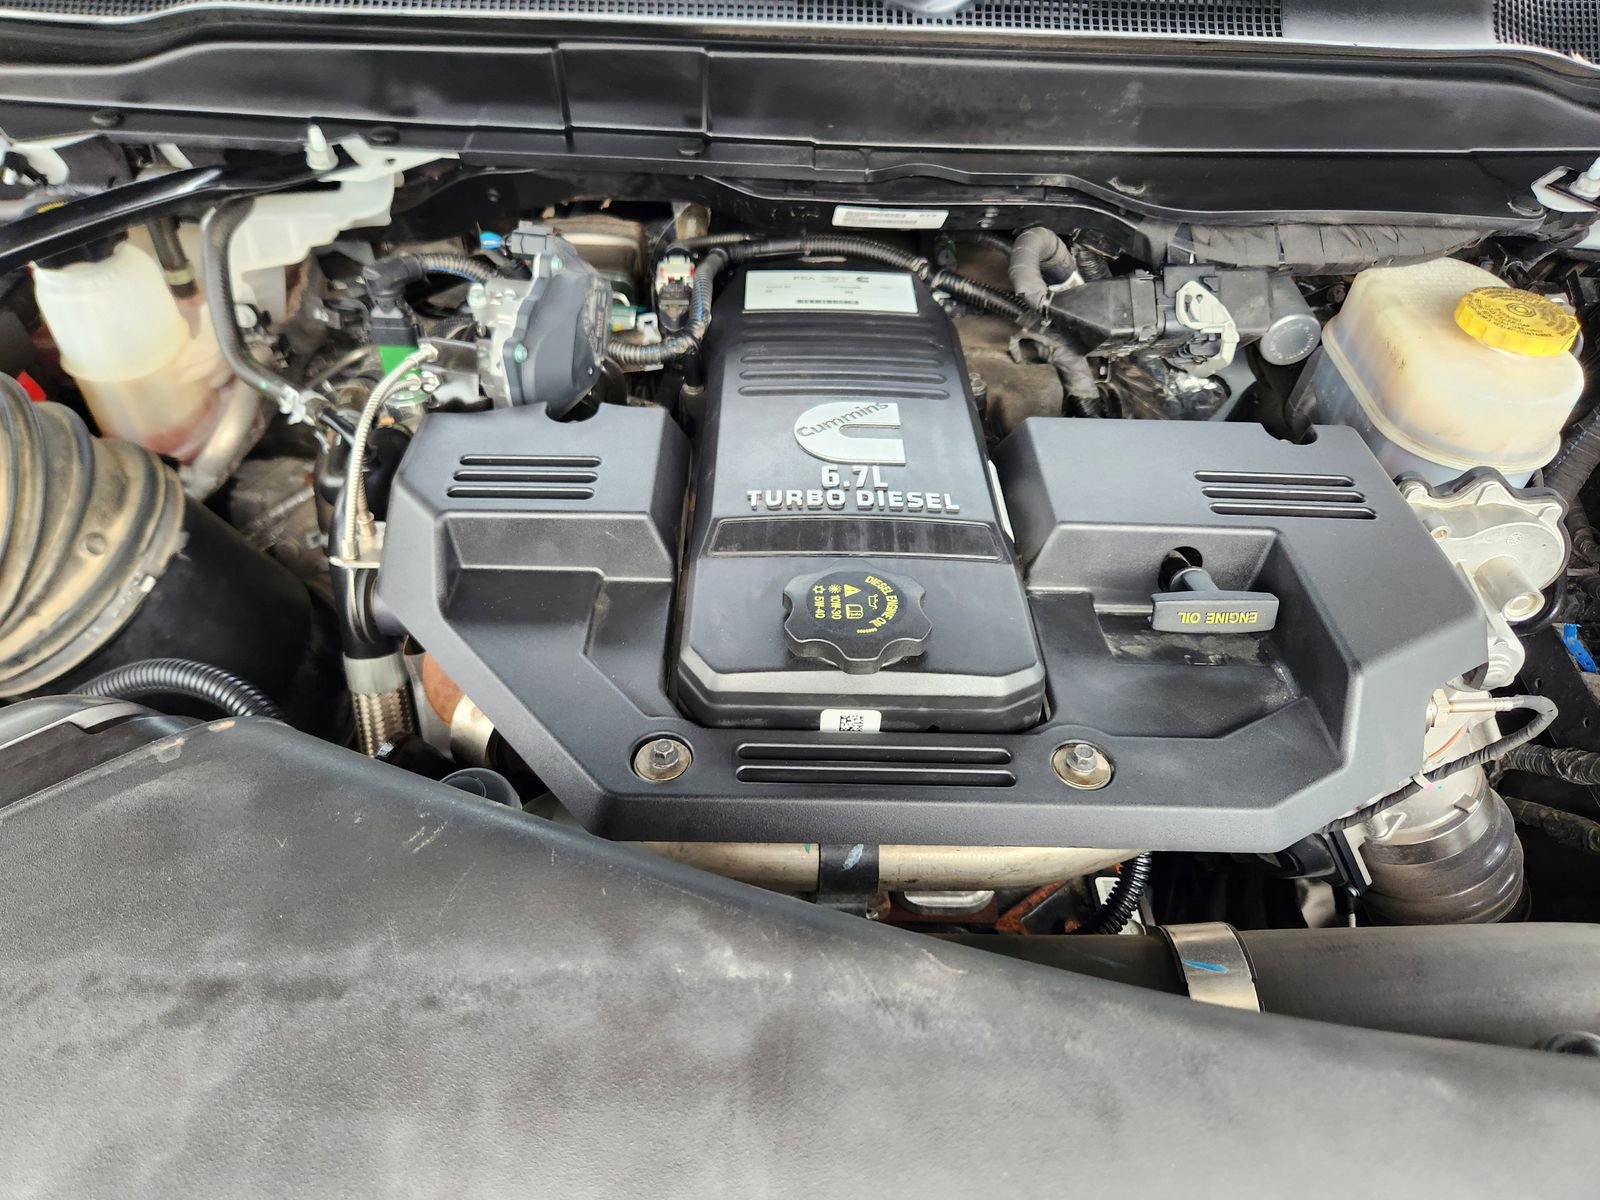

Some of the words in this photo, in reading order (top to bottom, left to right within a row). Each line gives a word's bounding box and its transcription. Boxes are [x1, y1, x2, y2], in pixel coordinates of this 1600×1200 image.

[797, 401, 888, 437] Cummins
[821, 465, 889, 491] 6.7L
[747, 489, 846, 511] TURBO
[856, 490, 960, 514] DIESEL
[865, 575, 893, 595] DIESEL
[814, 596, 826, 619] 5W-40
[881, 595, 898, 620] ENGINE
[1178, 611, 1201, 624] OIL
[1206, 611, 1258, 624] ENGINE
[869, 617, 887, 628] OIL
